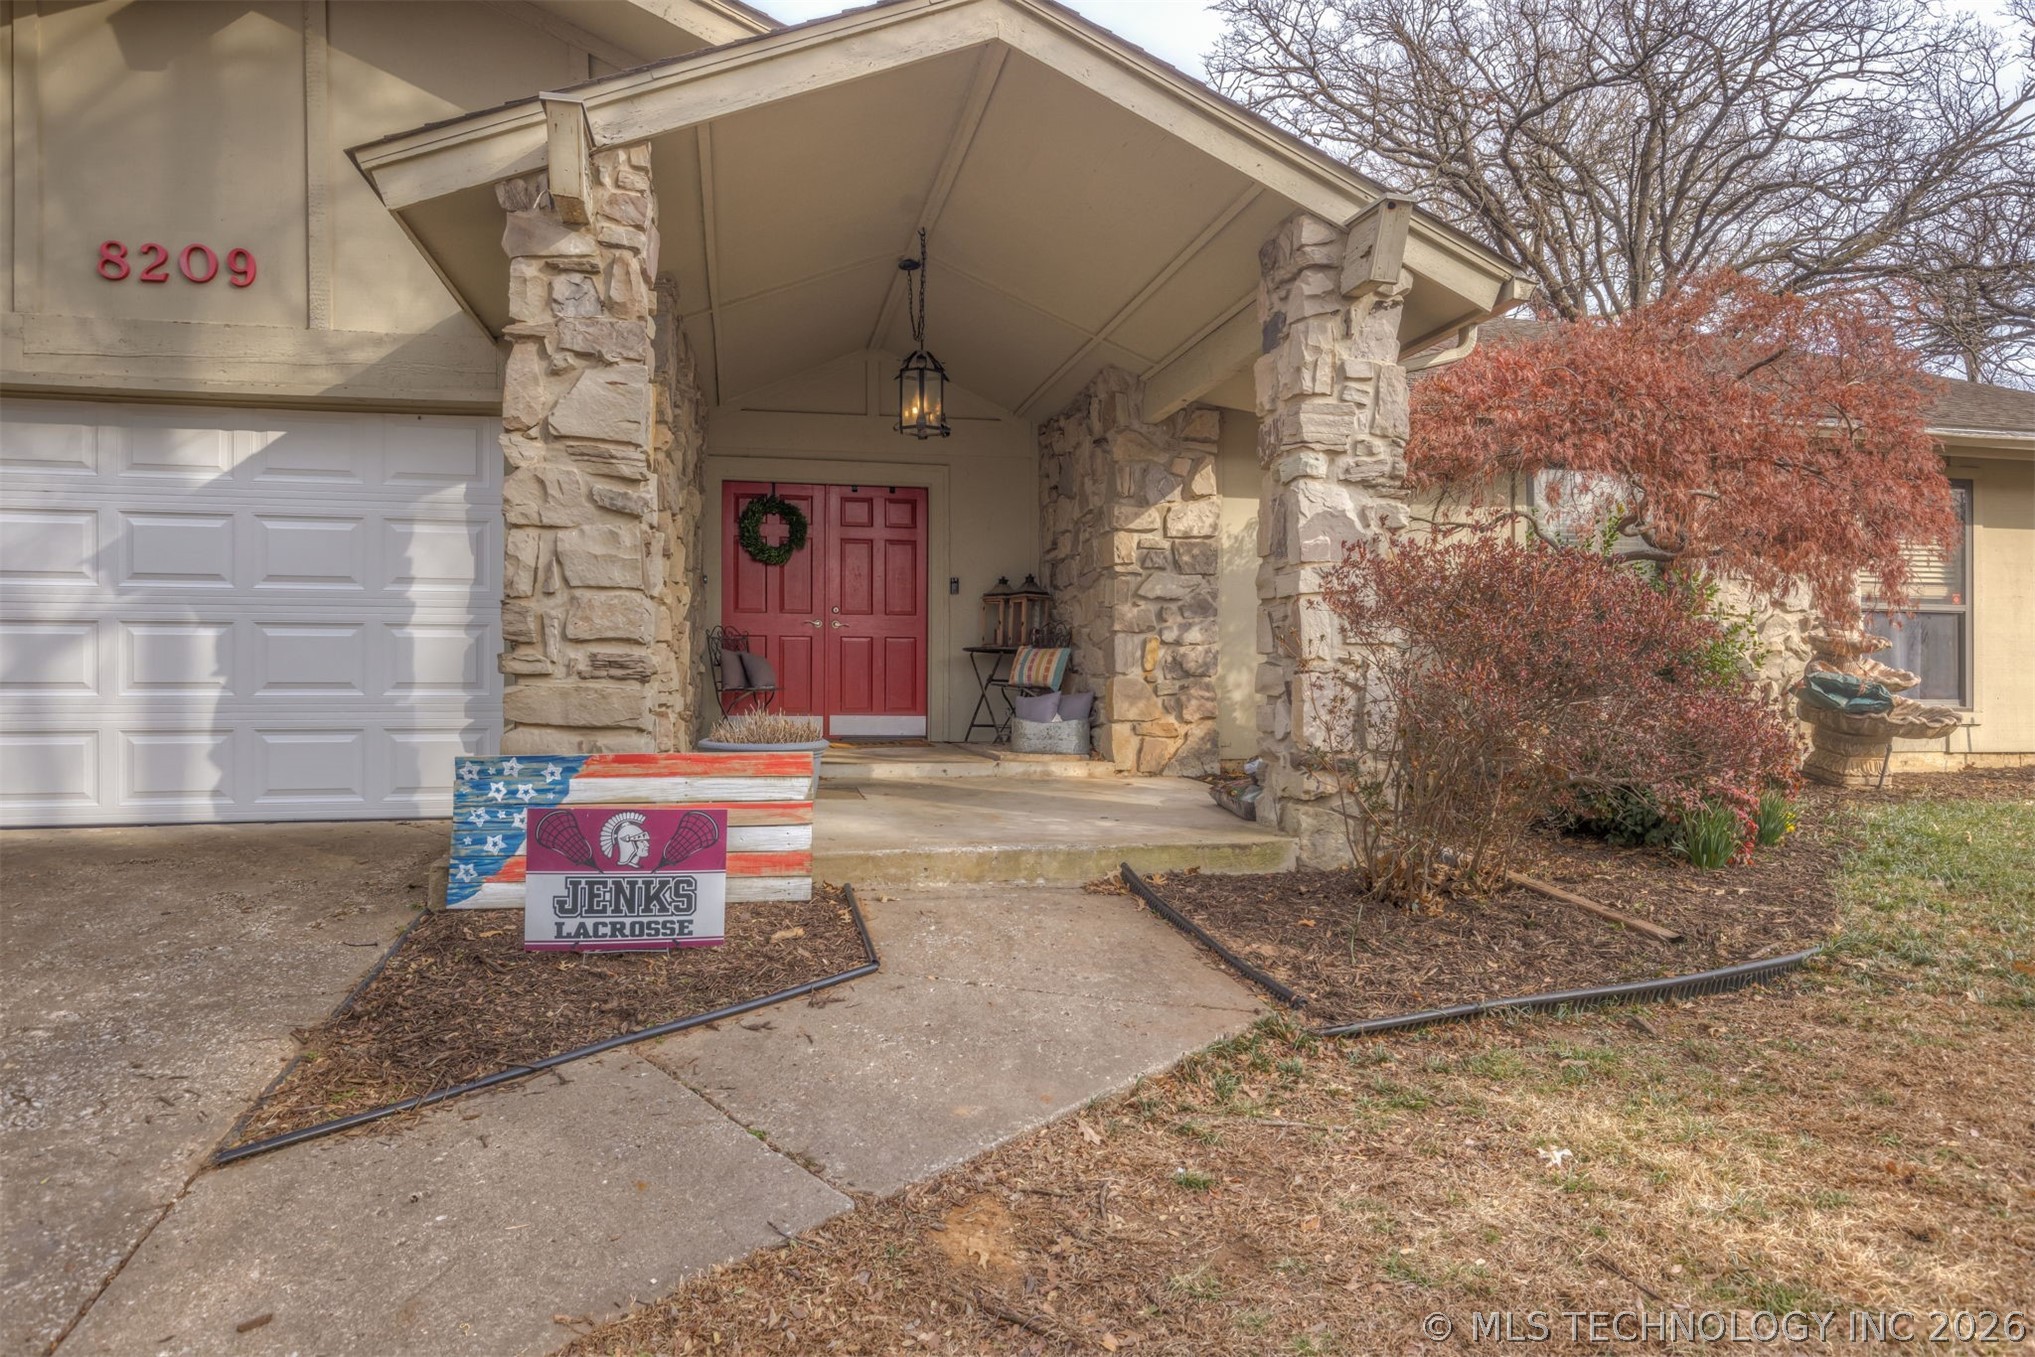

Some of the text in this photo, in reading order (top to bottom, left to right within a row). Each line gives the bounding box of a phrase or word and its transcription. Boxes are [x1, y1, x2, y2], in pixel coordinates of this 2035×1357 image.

[97, 240, 257, 287] 8209
[552, 875, 698, 918] JENKS
[554, 919, 694, 940] LACROSSE
